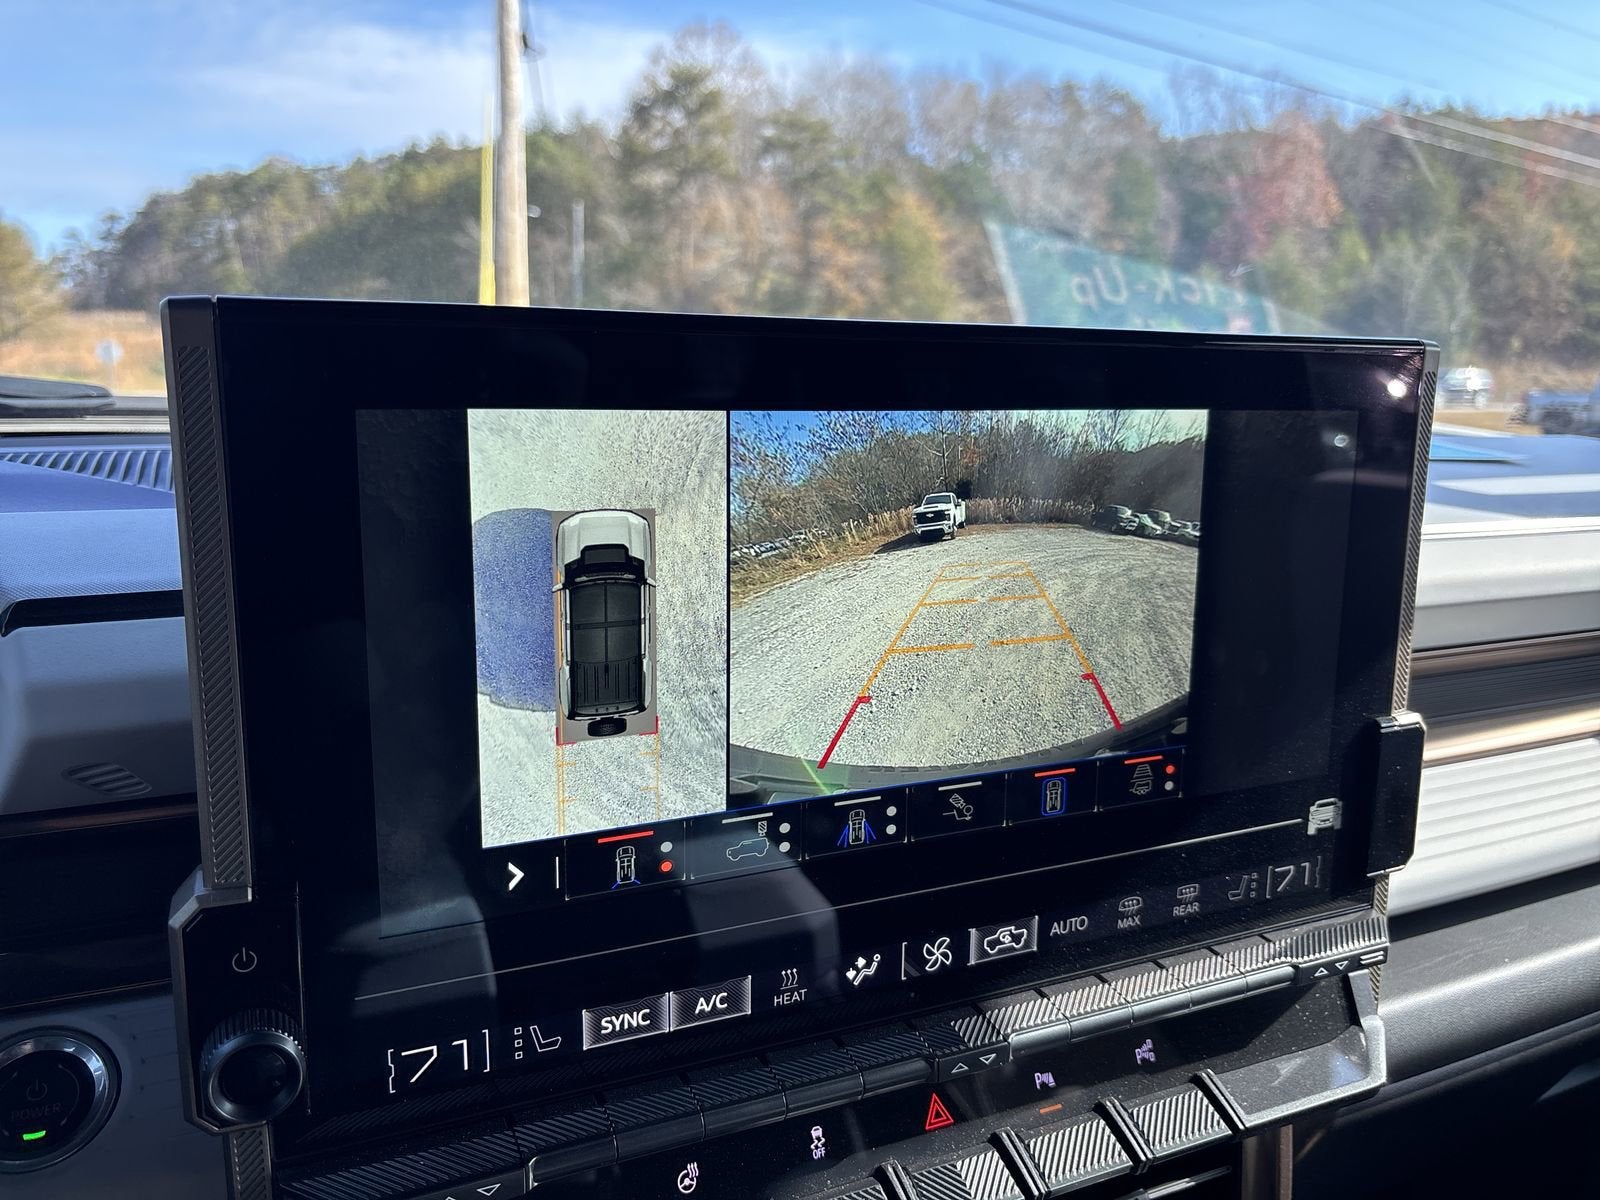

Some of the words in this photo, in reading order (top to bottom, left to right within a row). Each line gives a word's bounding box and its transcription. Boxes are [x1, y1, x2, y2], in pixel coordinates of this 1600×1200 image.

[1172, 901, 1200, 917] REAR
[1050, 915, 1089, 936] AUTO
[1116, 914, 1142, 930] MAX
[695, 992, 728, 1014] A/C
[773, 988, 808, 1006] HEAT
[600, 1008, 651, 1033] SYNC
[10, 1102, 62, 1122] POWER
[812, 1147, 826, 1160] OFF
